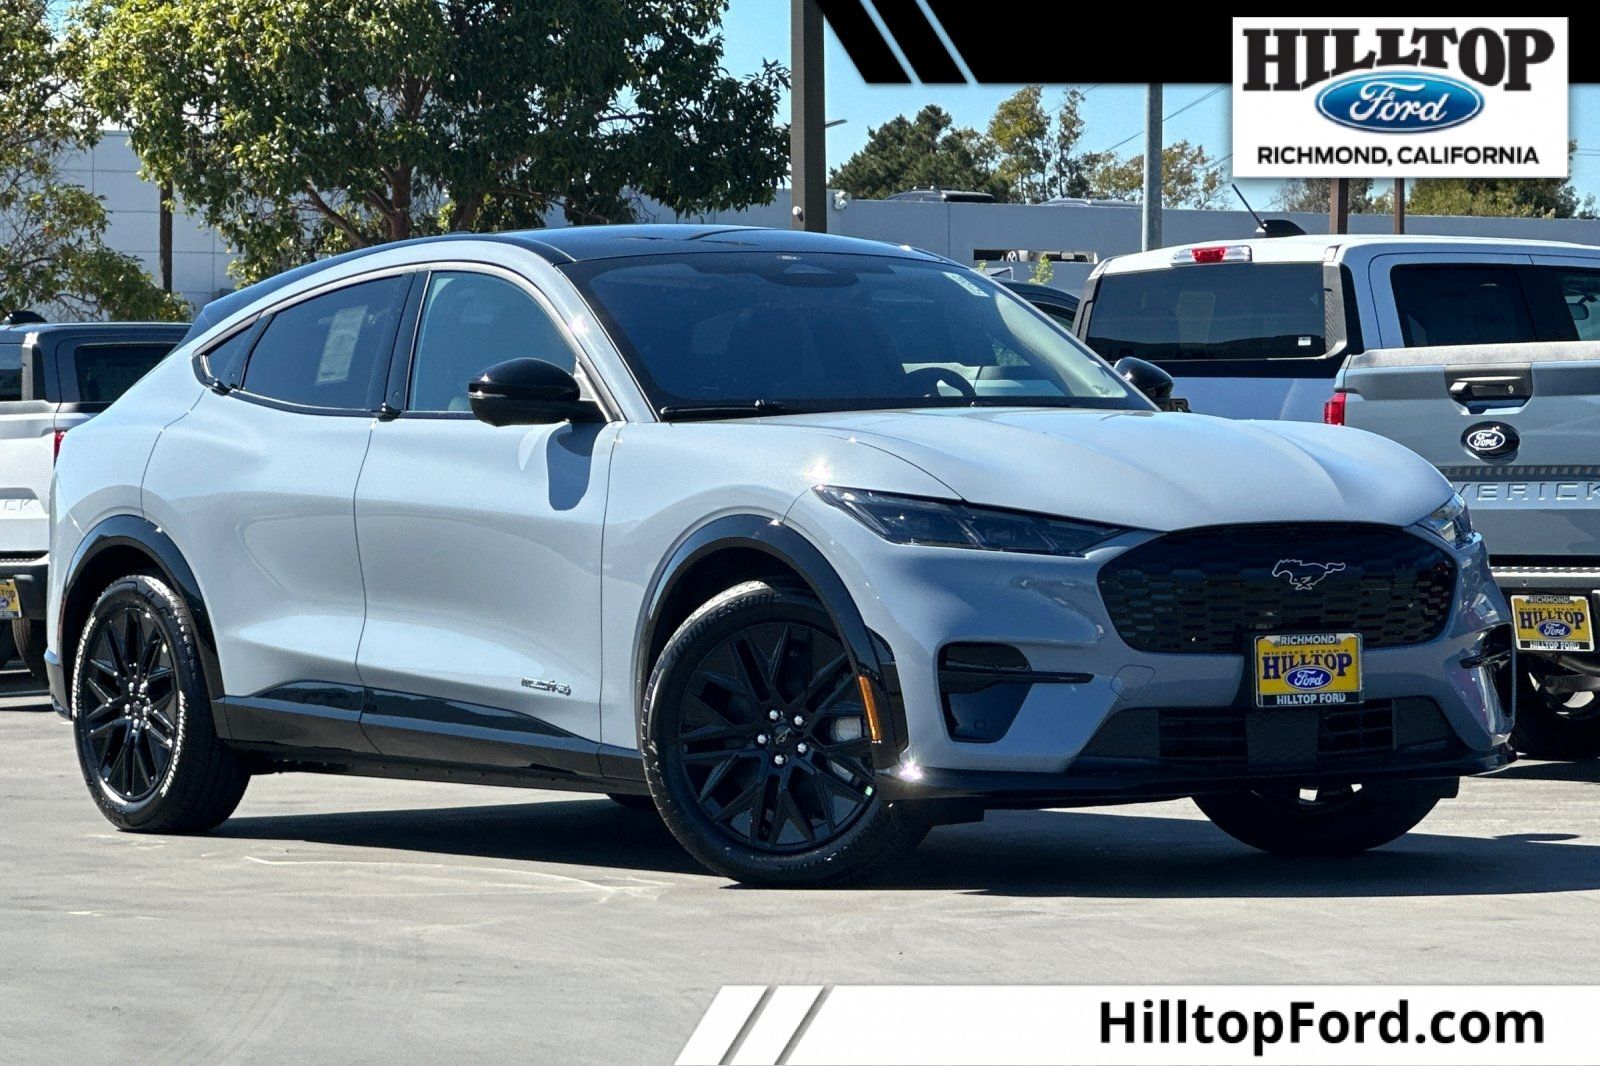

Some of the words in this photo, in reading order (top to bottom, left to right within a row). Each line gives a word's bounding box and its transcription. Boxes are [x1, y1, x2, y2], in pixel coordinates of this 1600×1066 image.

[1519, 610, 1585, 630] HILLTOP
[1543, 623, 1566, 636] Ford
[1280, 634, 1336, 646] RICHMOND
[1262, 653, 1353, 680] HILLTOP
[1294, 669, 1324, 687] Ford
[1276, 693, 1317, 705] HILLTOP
[1319, 692, 1346, 703] FORD
